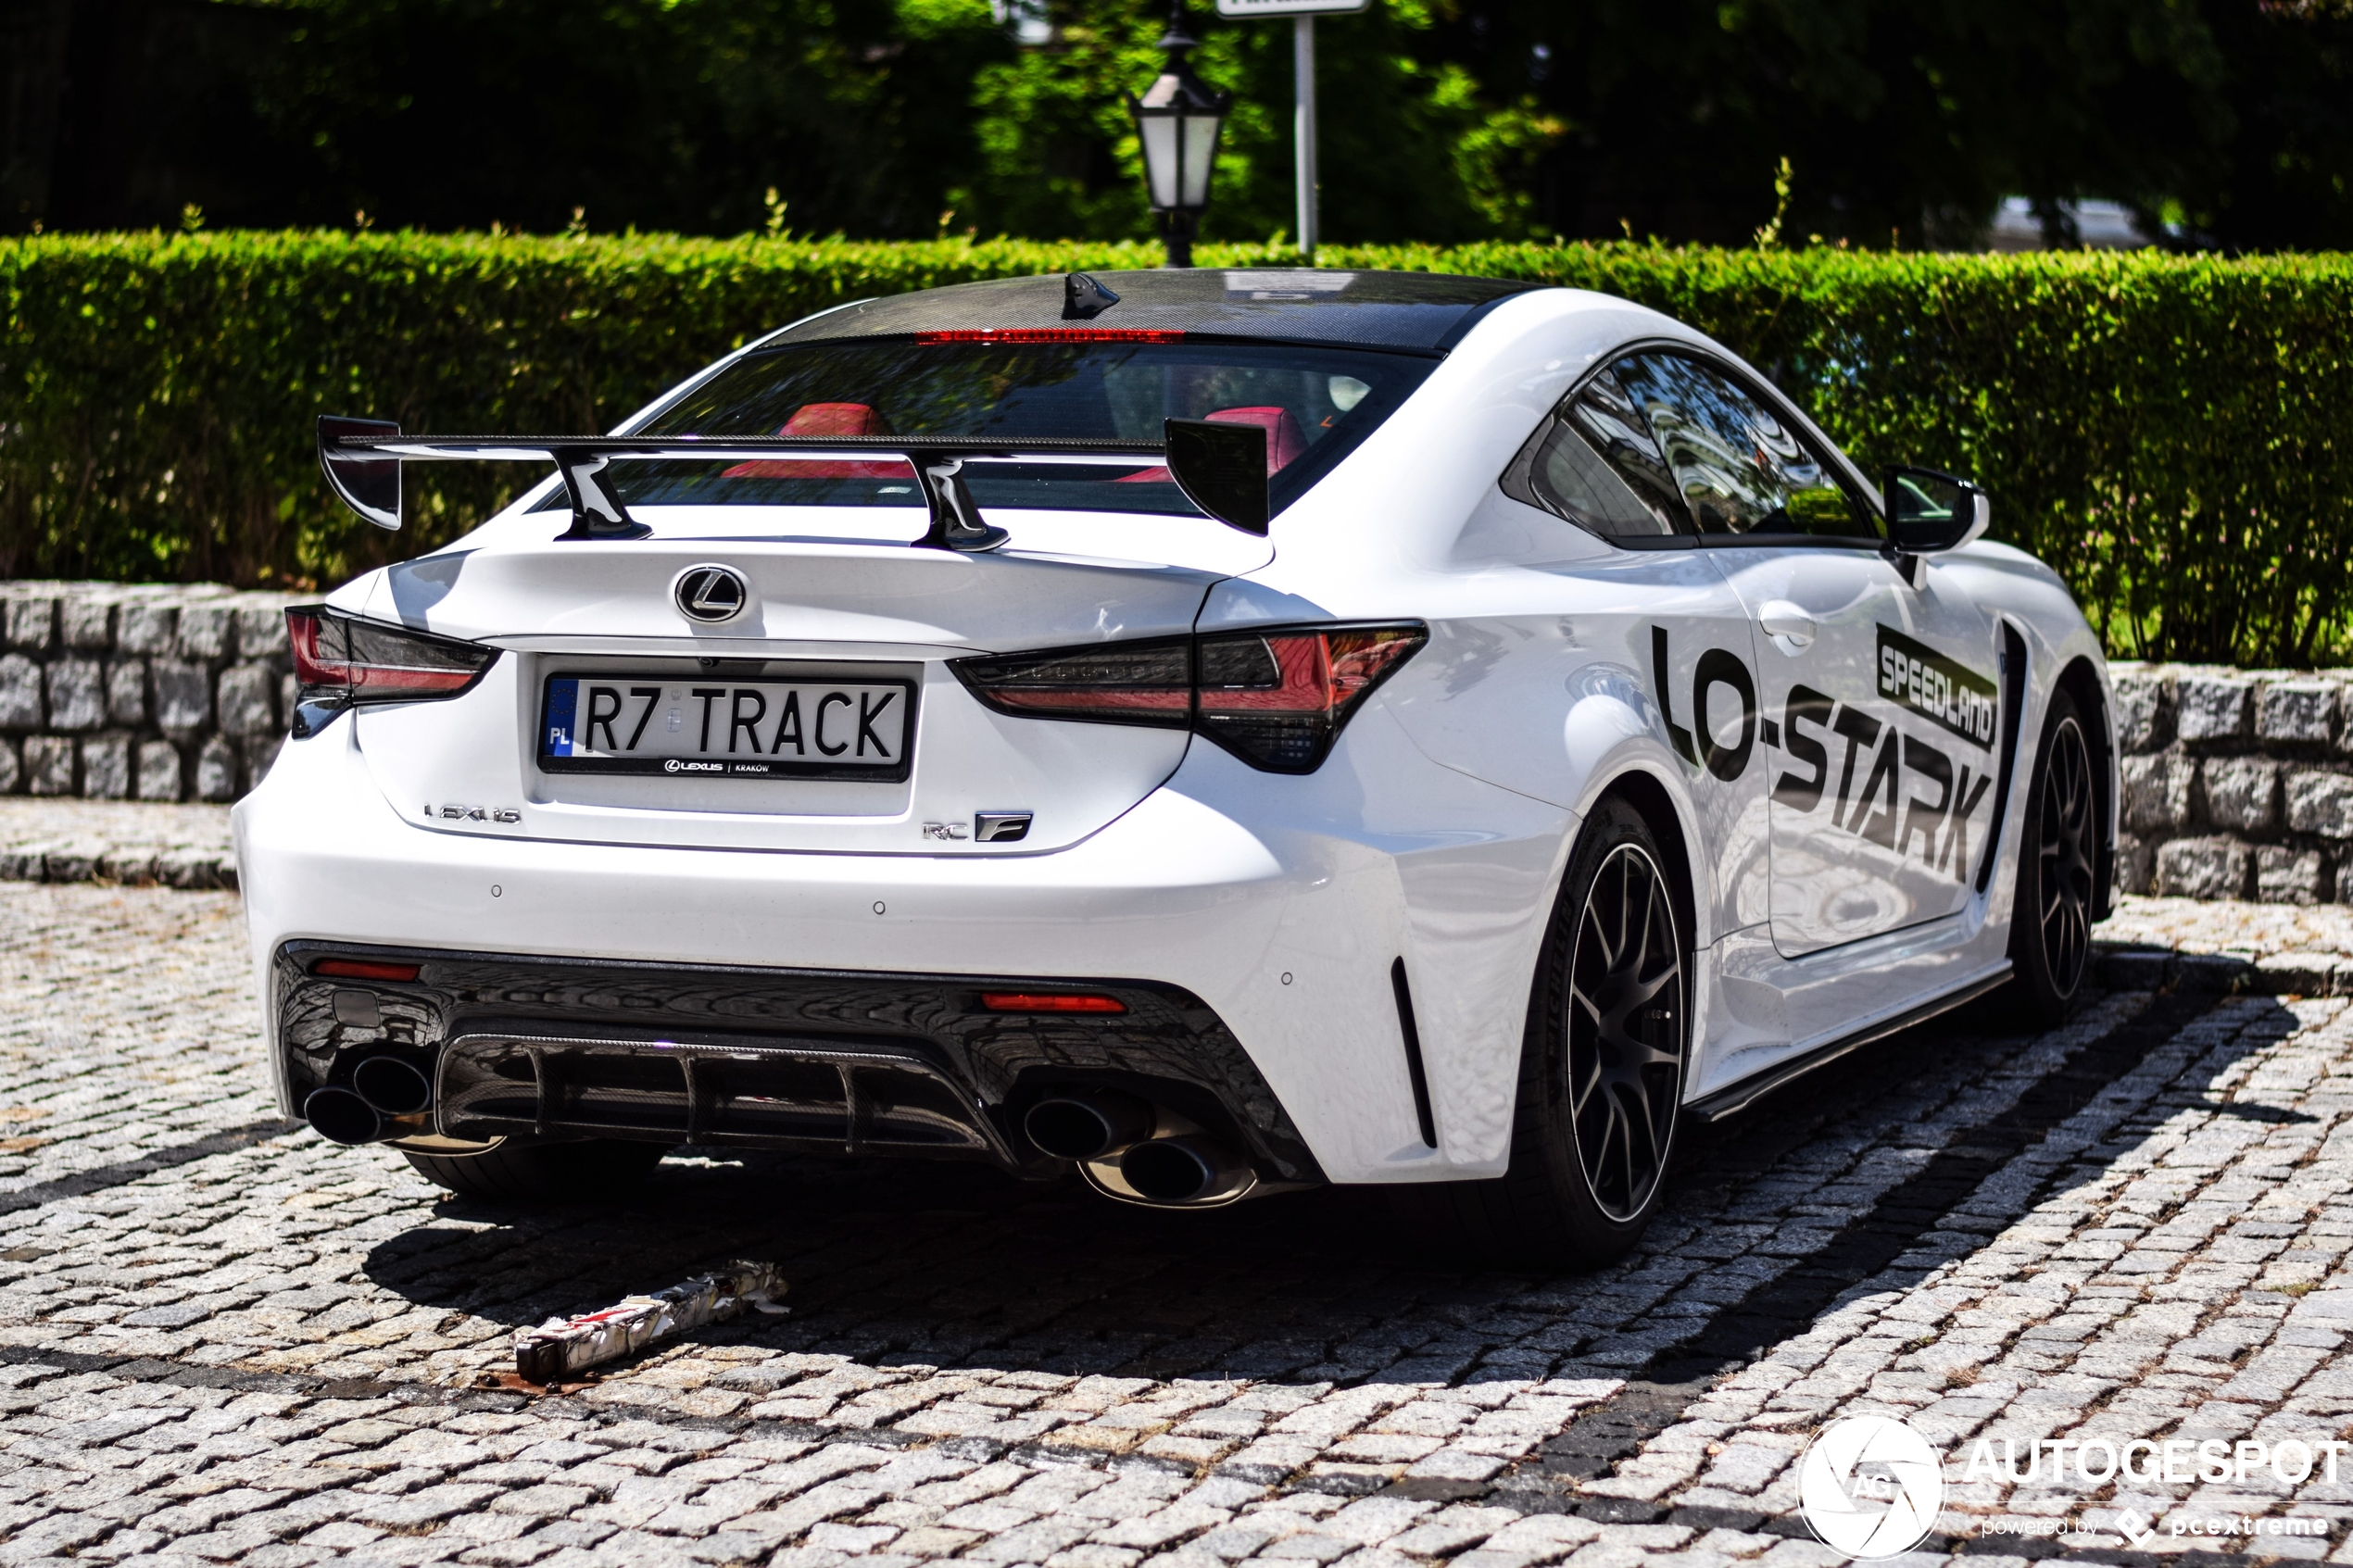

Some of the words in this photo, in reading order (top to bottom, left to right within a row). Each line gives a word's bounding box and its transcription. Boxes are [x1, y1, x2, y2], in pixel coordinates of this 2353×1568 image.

[1881, 645, 1993, 742] SPEEDLAND
[585, 687, 661, 752] R7
[691, 688, 897, 758] TRACK
[549, 727, 570, 746] PL
[681, 762, 723, 771] LEXUS
[922, 822, 969, 840] RC
